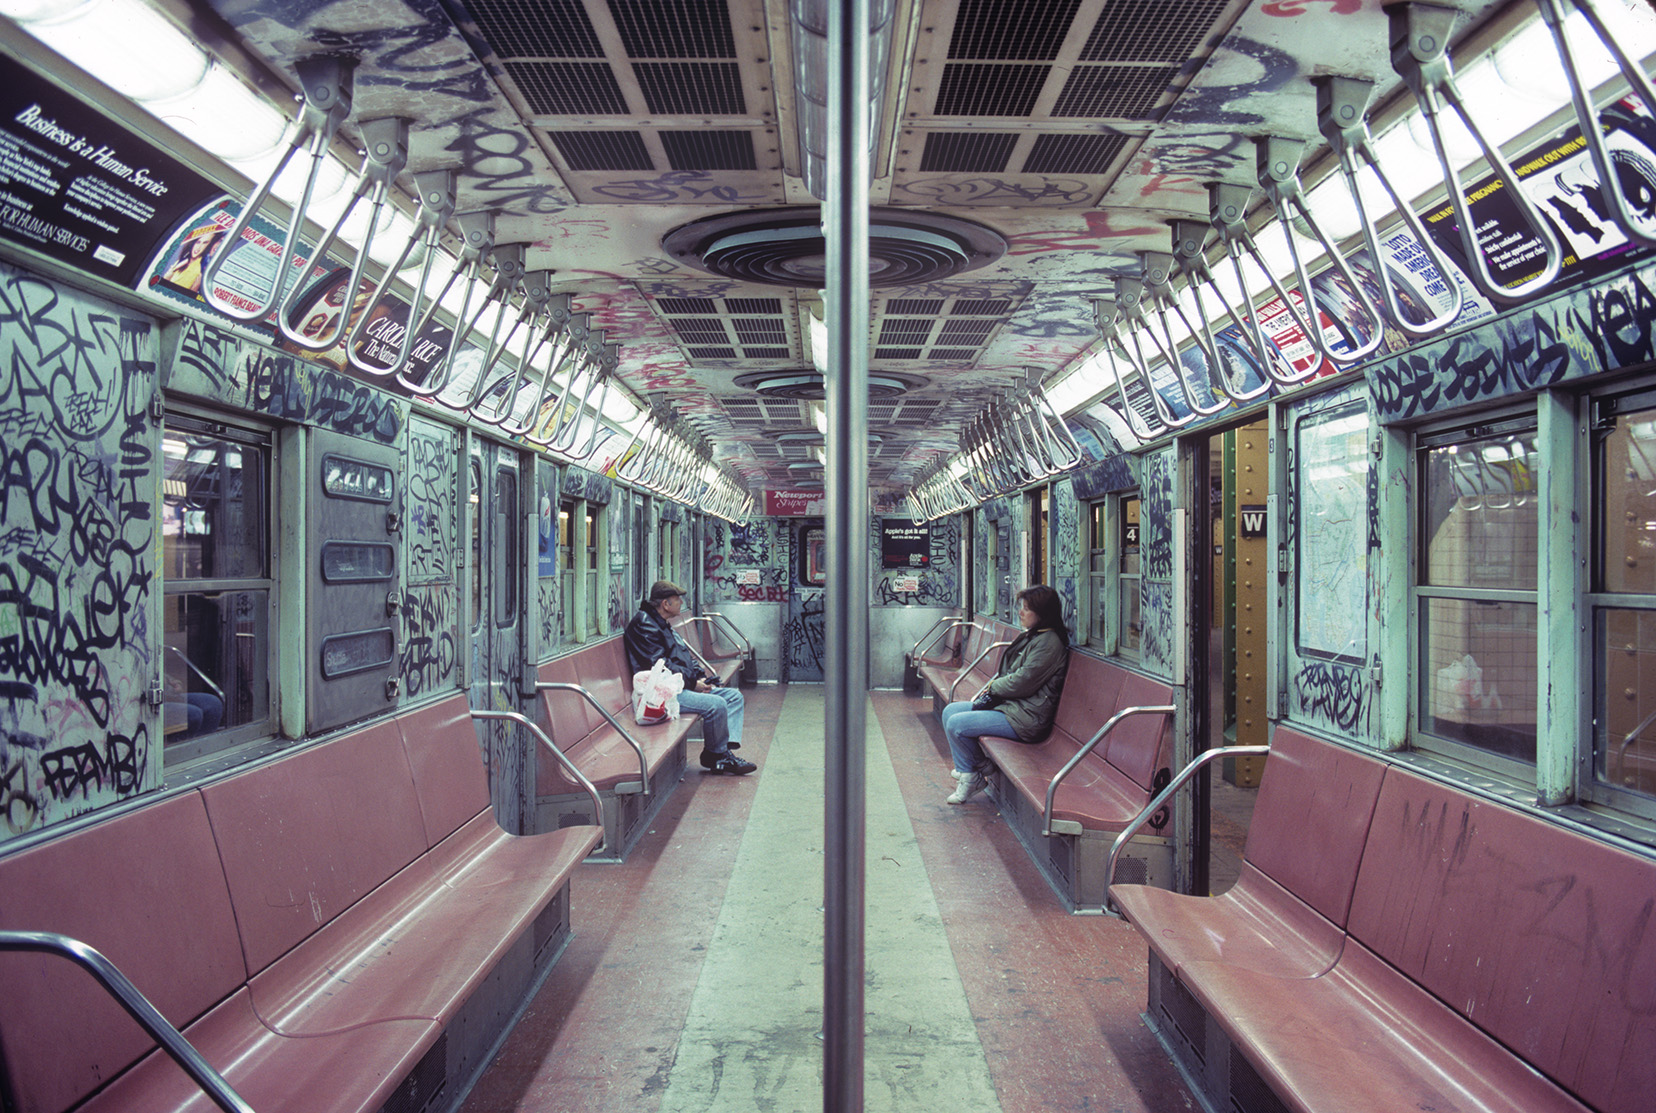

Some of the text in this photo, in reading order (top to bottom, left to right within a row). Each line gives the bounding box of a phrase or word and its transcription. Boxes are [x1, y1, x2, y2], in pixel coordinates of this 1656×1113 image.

[15, 102, 76, 146] Business
[68, 137, 87, 152] is
[79, 146, 95, 158] a
[87, 145, 134, 179] Human
[127, 168, 169, 197] Service
[1527, 156, 1548, 171] WALK
[1543, 149, 1562, 163] OUT
[1557, 140, 1581, 156] WITH
[0, 204, 21, 224] FOR
[17, 212, 58, 239] HUMAN
[1391, 240, 1425, 264] MADE OU
[213, 286, 233, 302] ROBERT
[231, 293, 249, 310] FIANCE
[1424, 280, 1447, 297] COME
[364, 338, 380, 358] The
[410, 339, 443, 363] RICE
[774, 491, 823, 500] Newport
[885, 528, 904, 536] Apple's
[904, 528, 913, 536] got
[1243, 513, 1264, 532] W
[1127, 528, 1136, 541] 4
